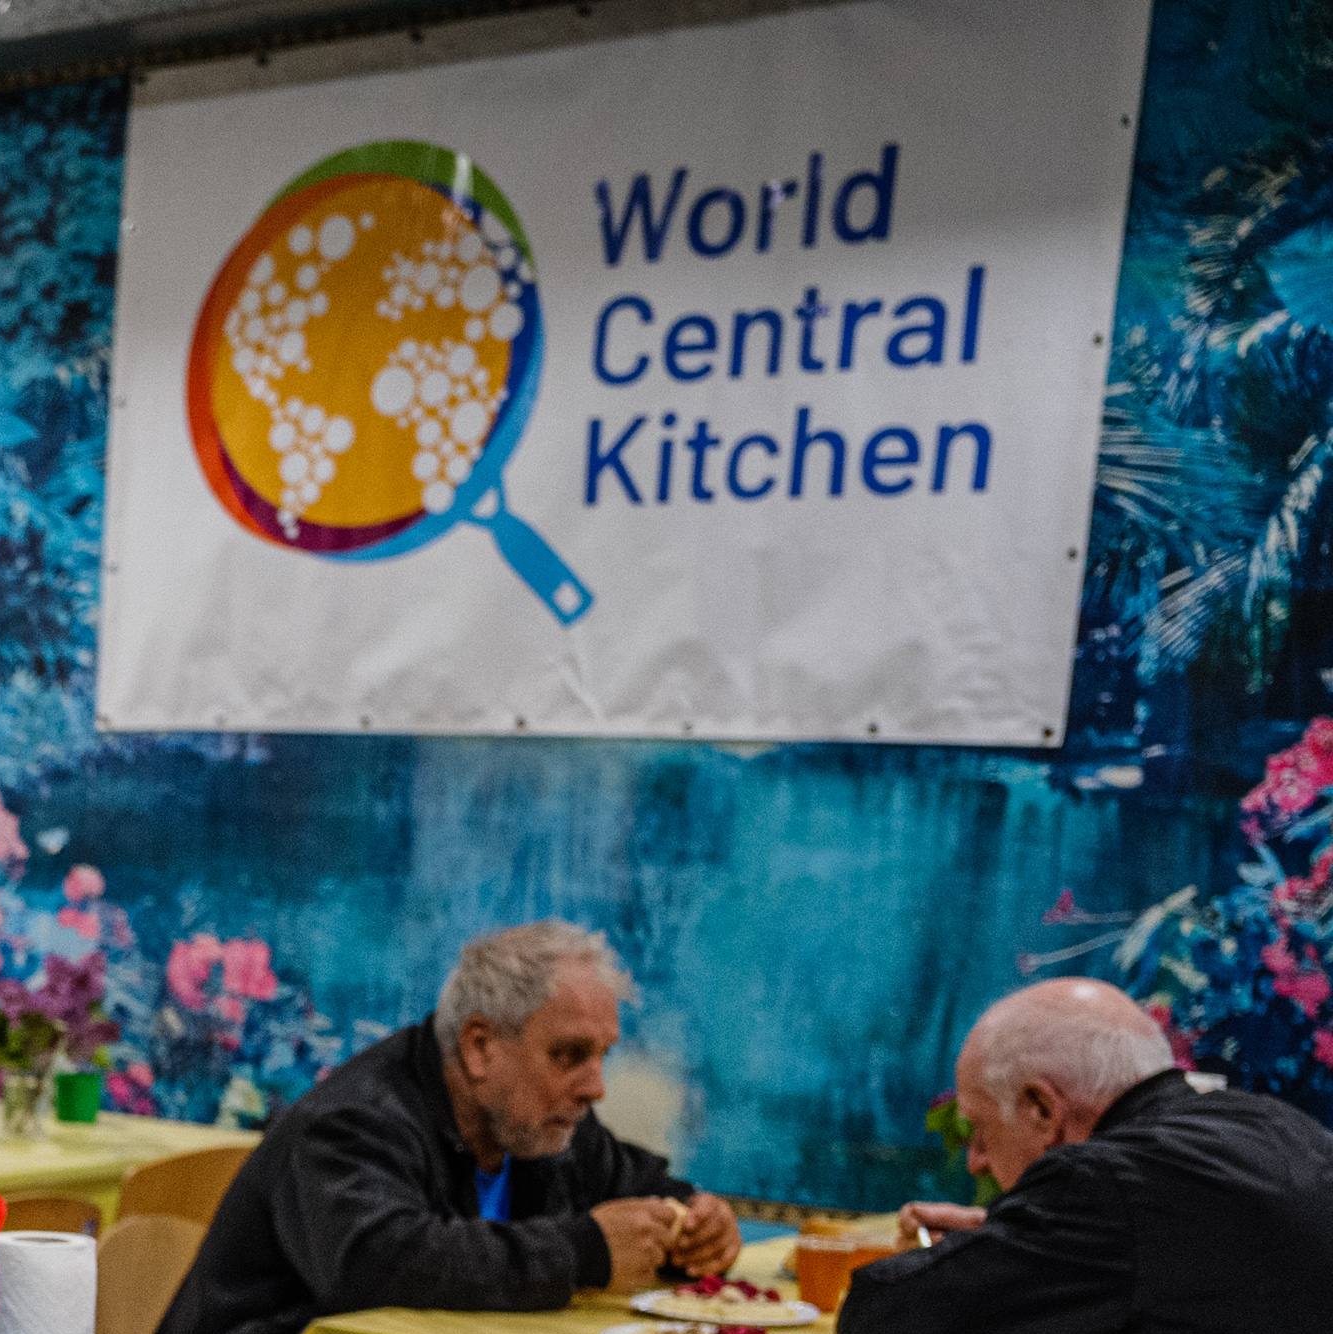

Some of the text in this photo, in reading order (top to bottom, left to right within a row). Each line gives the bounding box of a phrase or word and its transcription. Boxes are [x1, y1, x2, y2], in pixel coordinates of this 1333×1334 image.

[595, 143, 902, 268] World
[593, 264, 986, 388] Central
[583, 406, 995, 506] Kitchen
